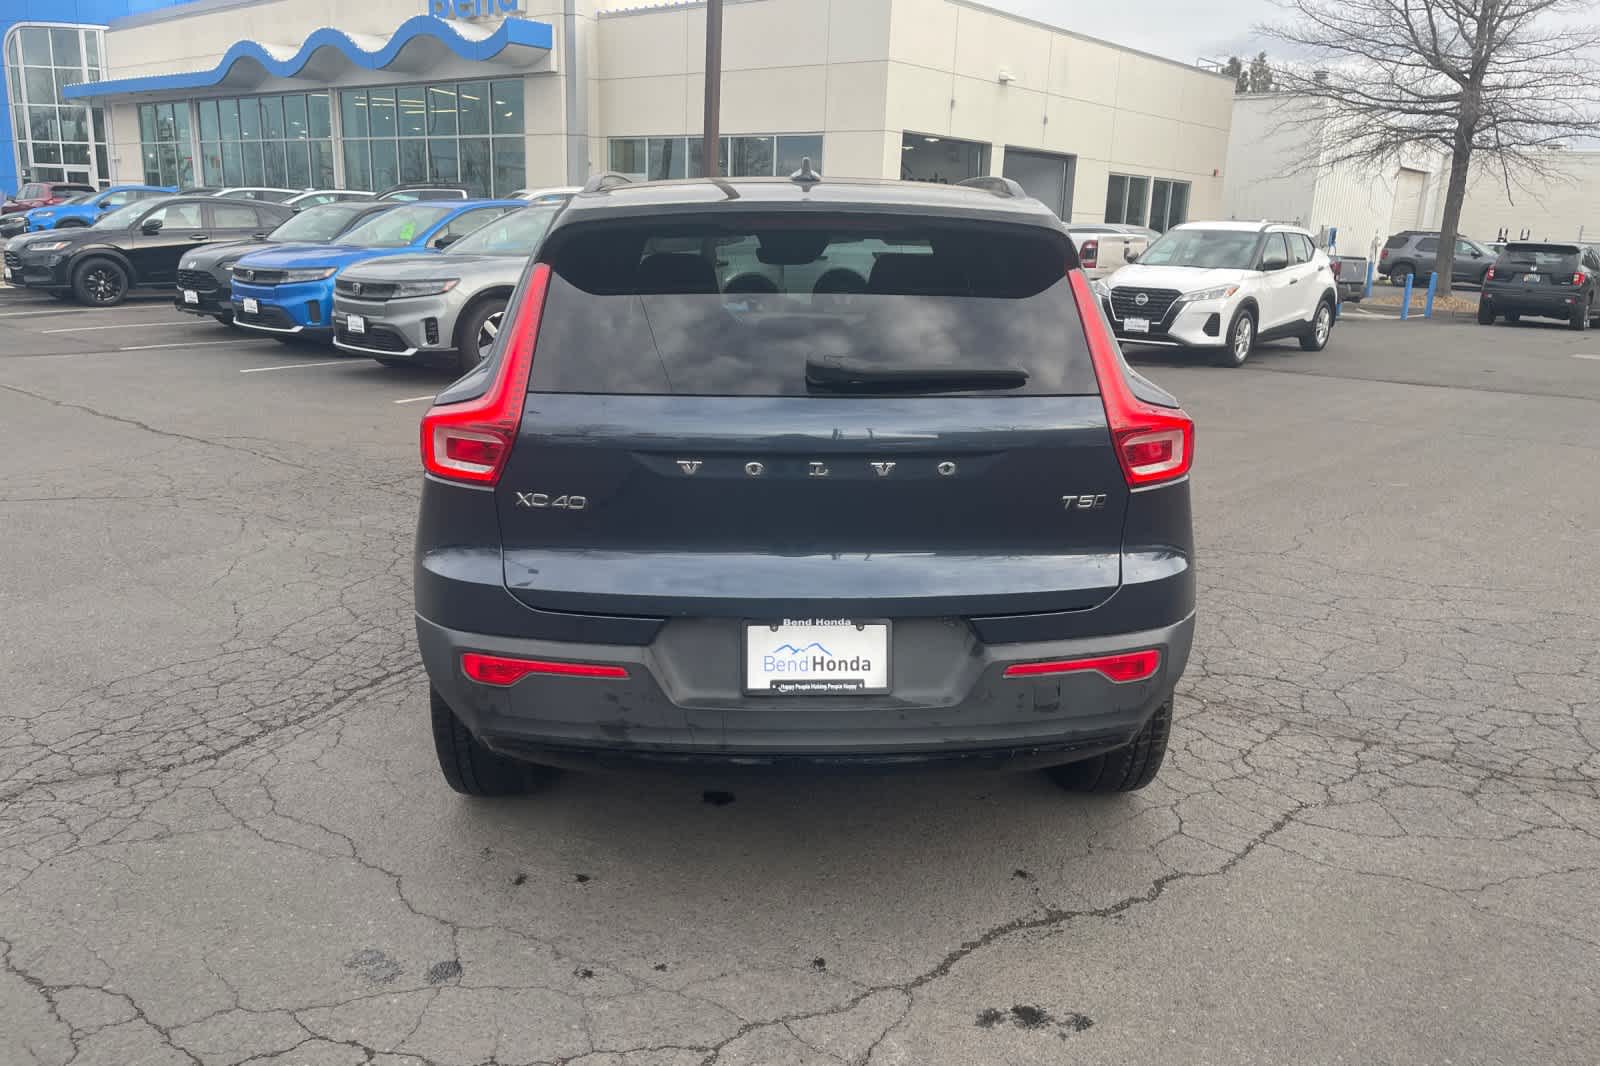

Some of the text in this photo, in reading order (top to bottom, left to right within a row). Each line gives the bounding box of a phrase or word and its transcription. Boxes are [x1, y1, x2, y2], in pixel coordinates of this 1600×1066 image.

[676, 460, 956, 477] VOLVO
[783, 618, 852, 626] Bend Honda
